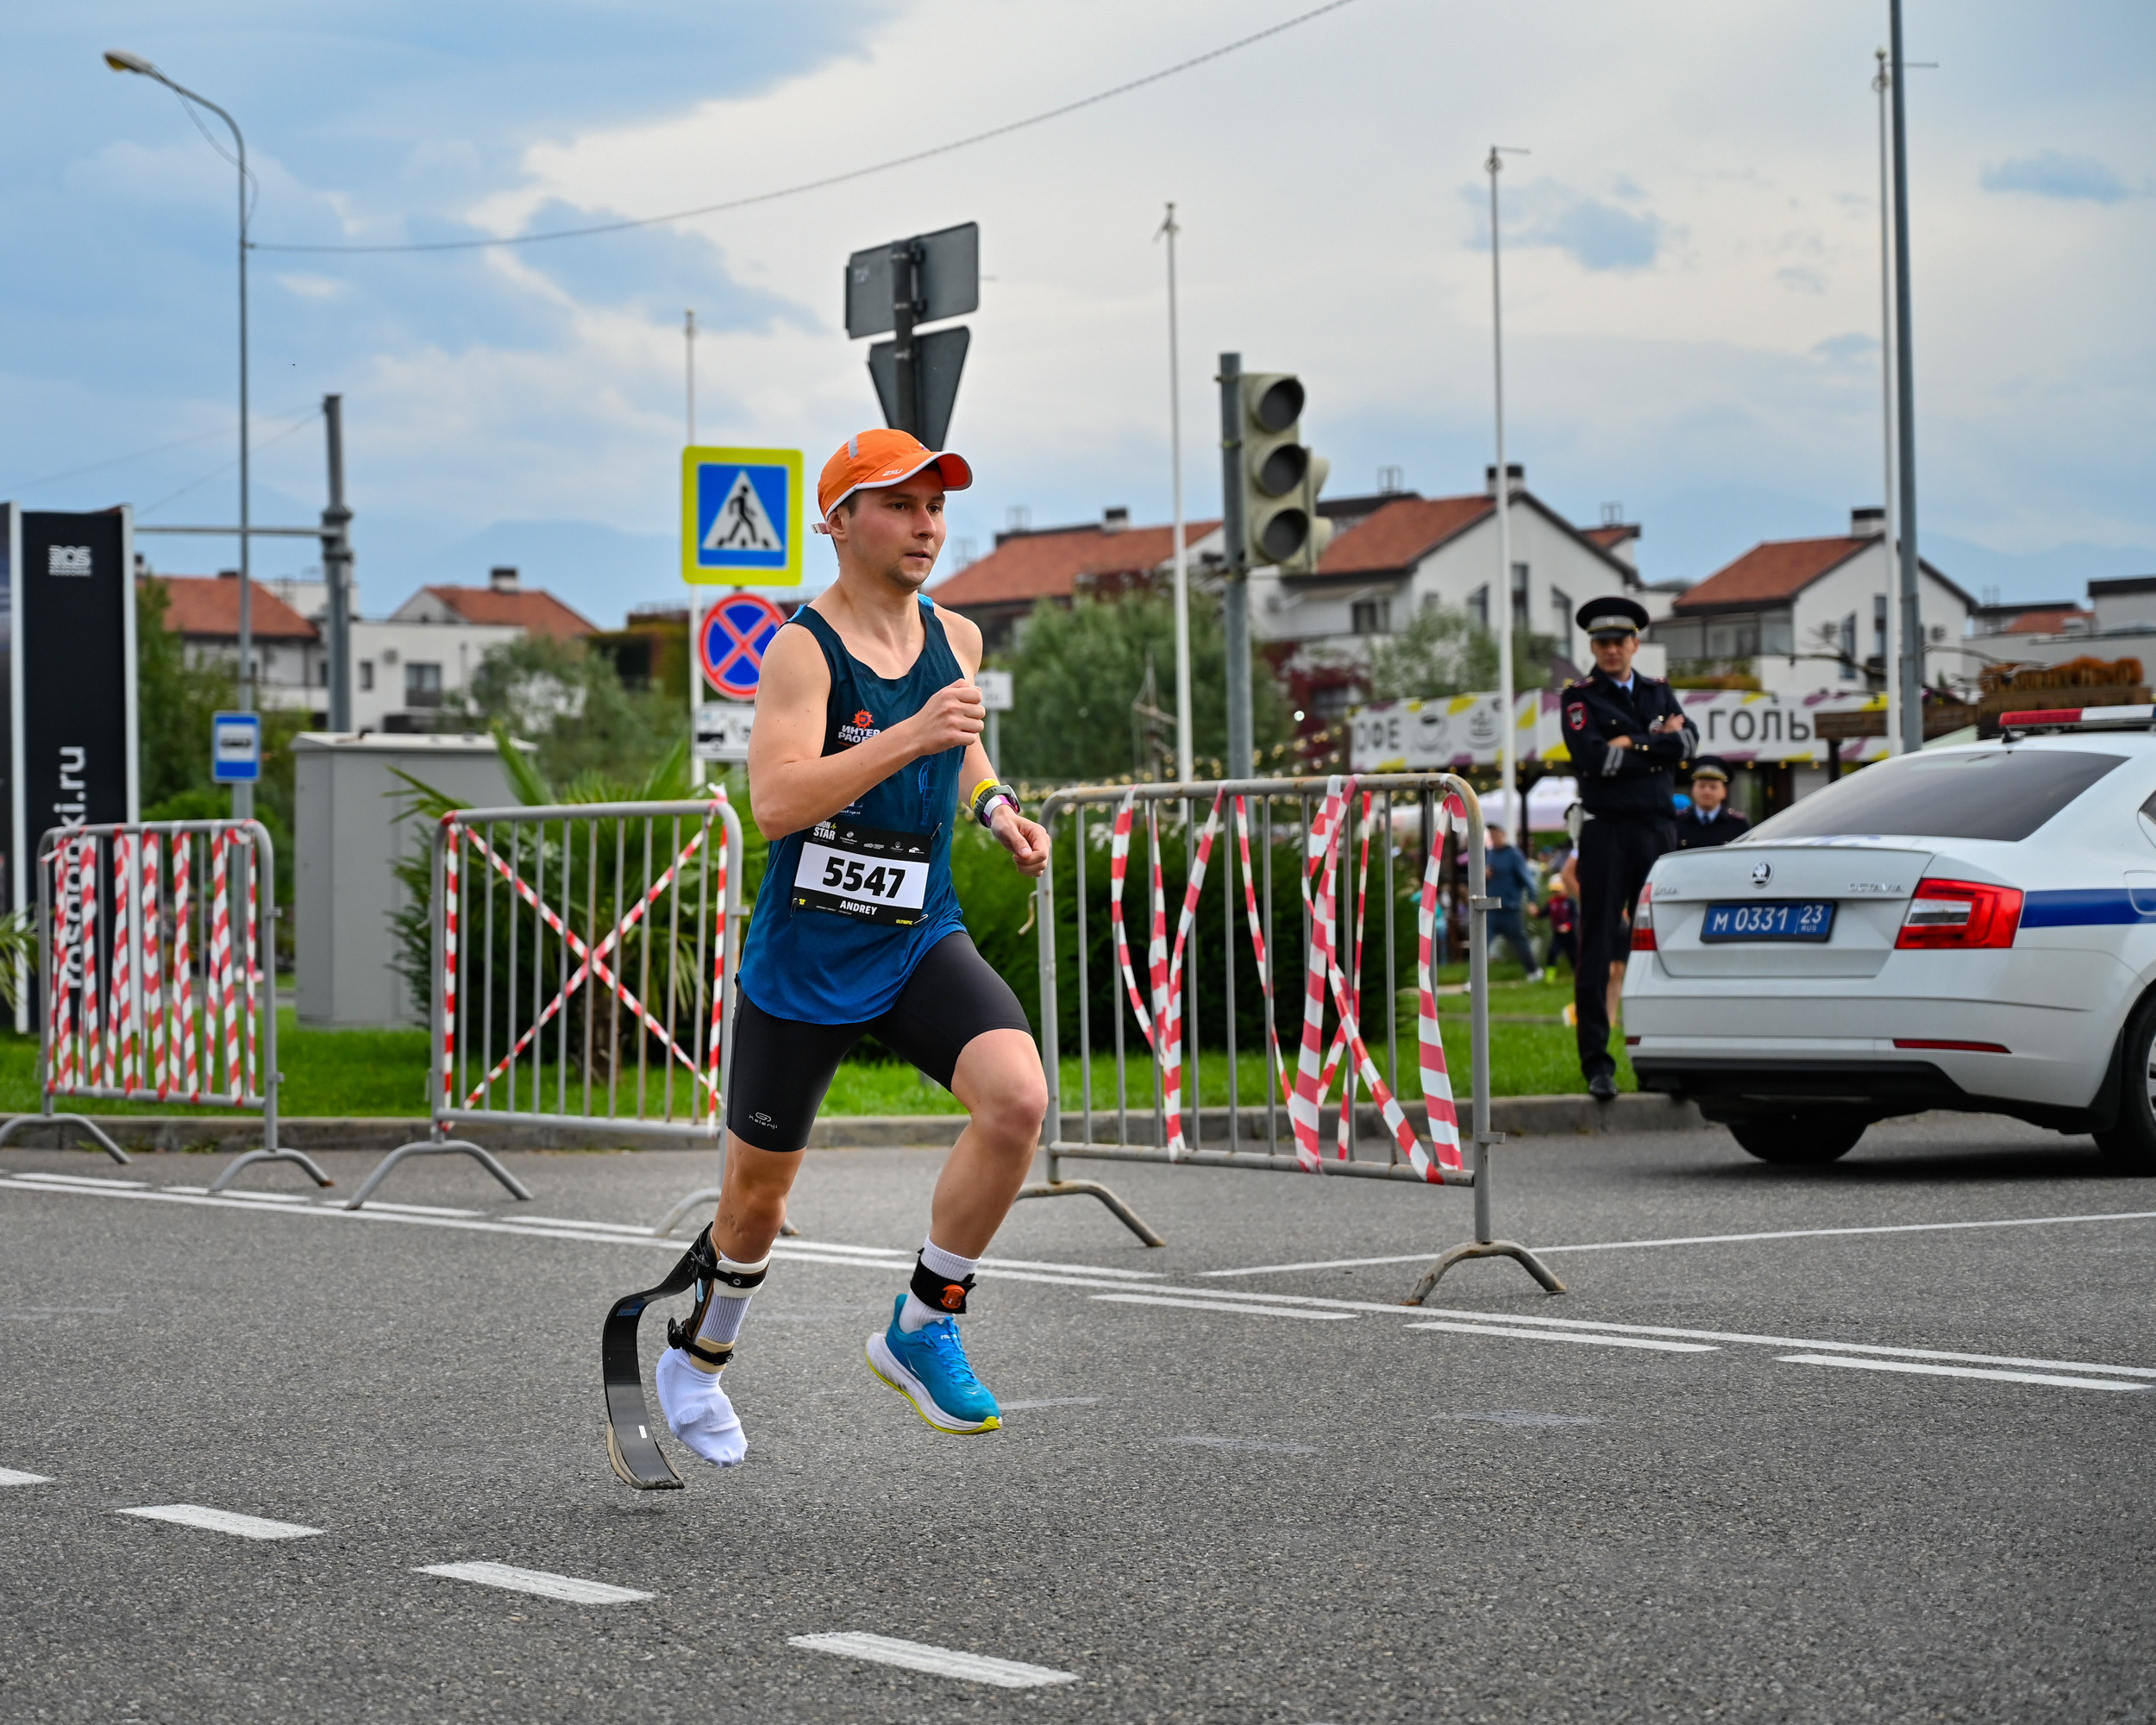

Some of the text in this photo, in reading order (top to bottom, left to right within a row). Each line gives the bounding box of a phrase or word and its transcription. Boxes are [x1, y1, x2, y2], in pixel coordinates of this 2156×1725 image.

[837, 731, 862, 743] РАО
[813, 826, 836, 841] STAR
[822, 856, 906, 899] 5547
[839, 900, 878, 916] ANDREY
[1734, 906, 1789, 932] 0331
[1800, 905, 1824, 925] 23
